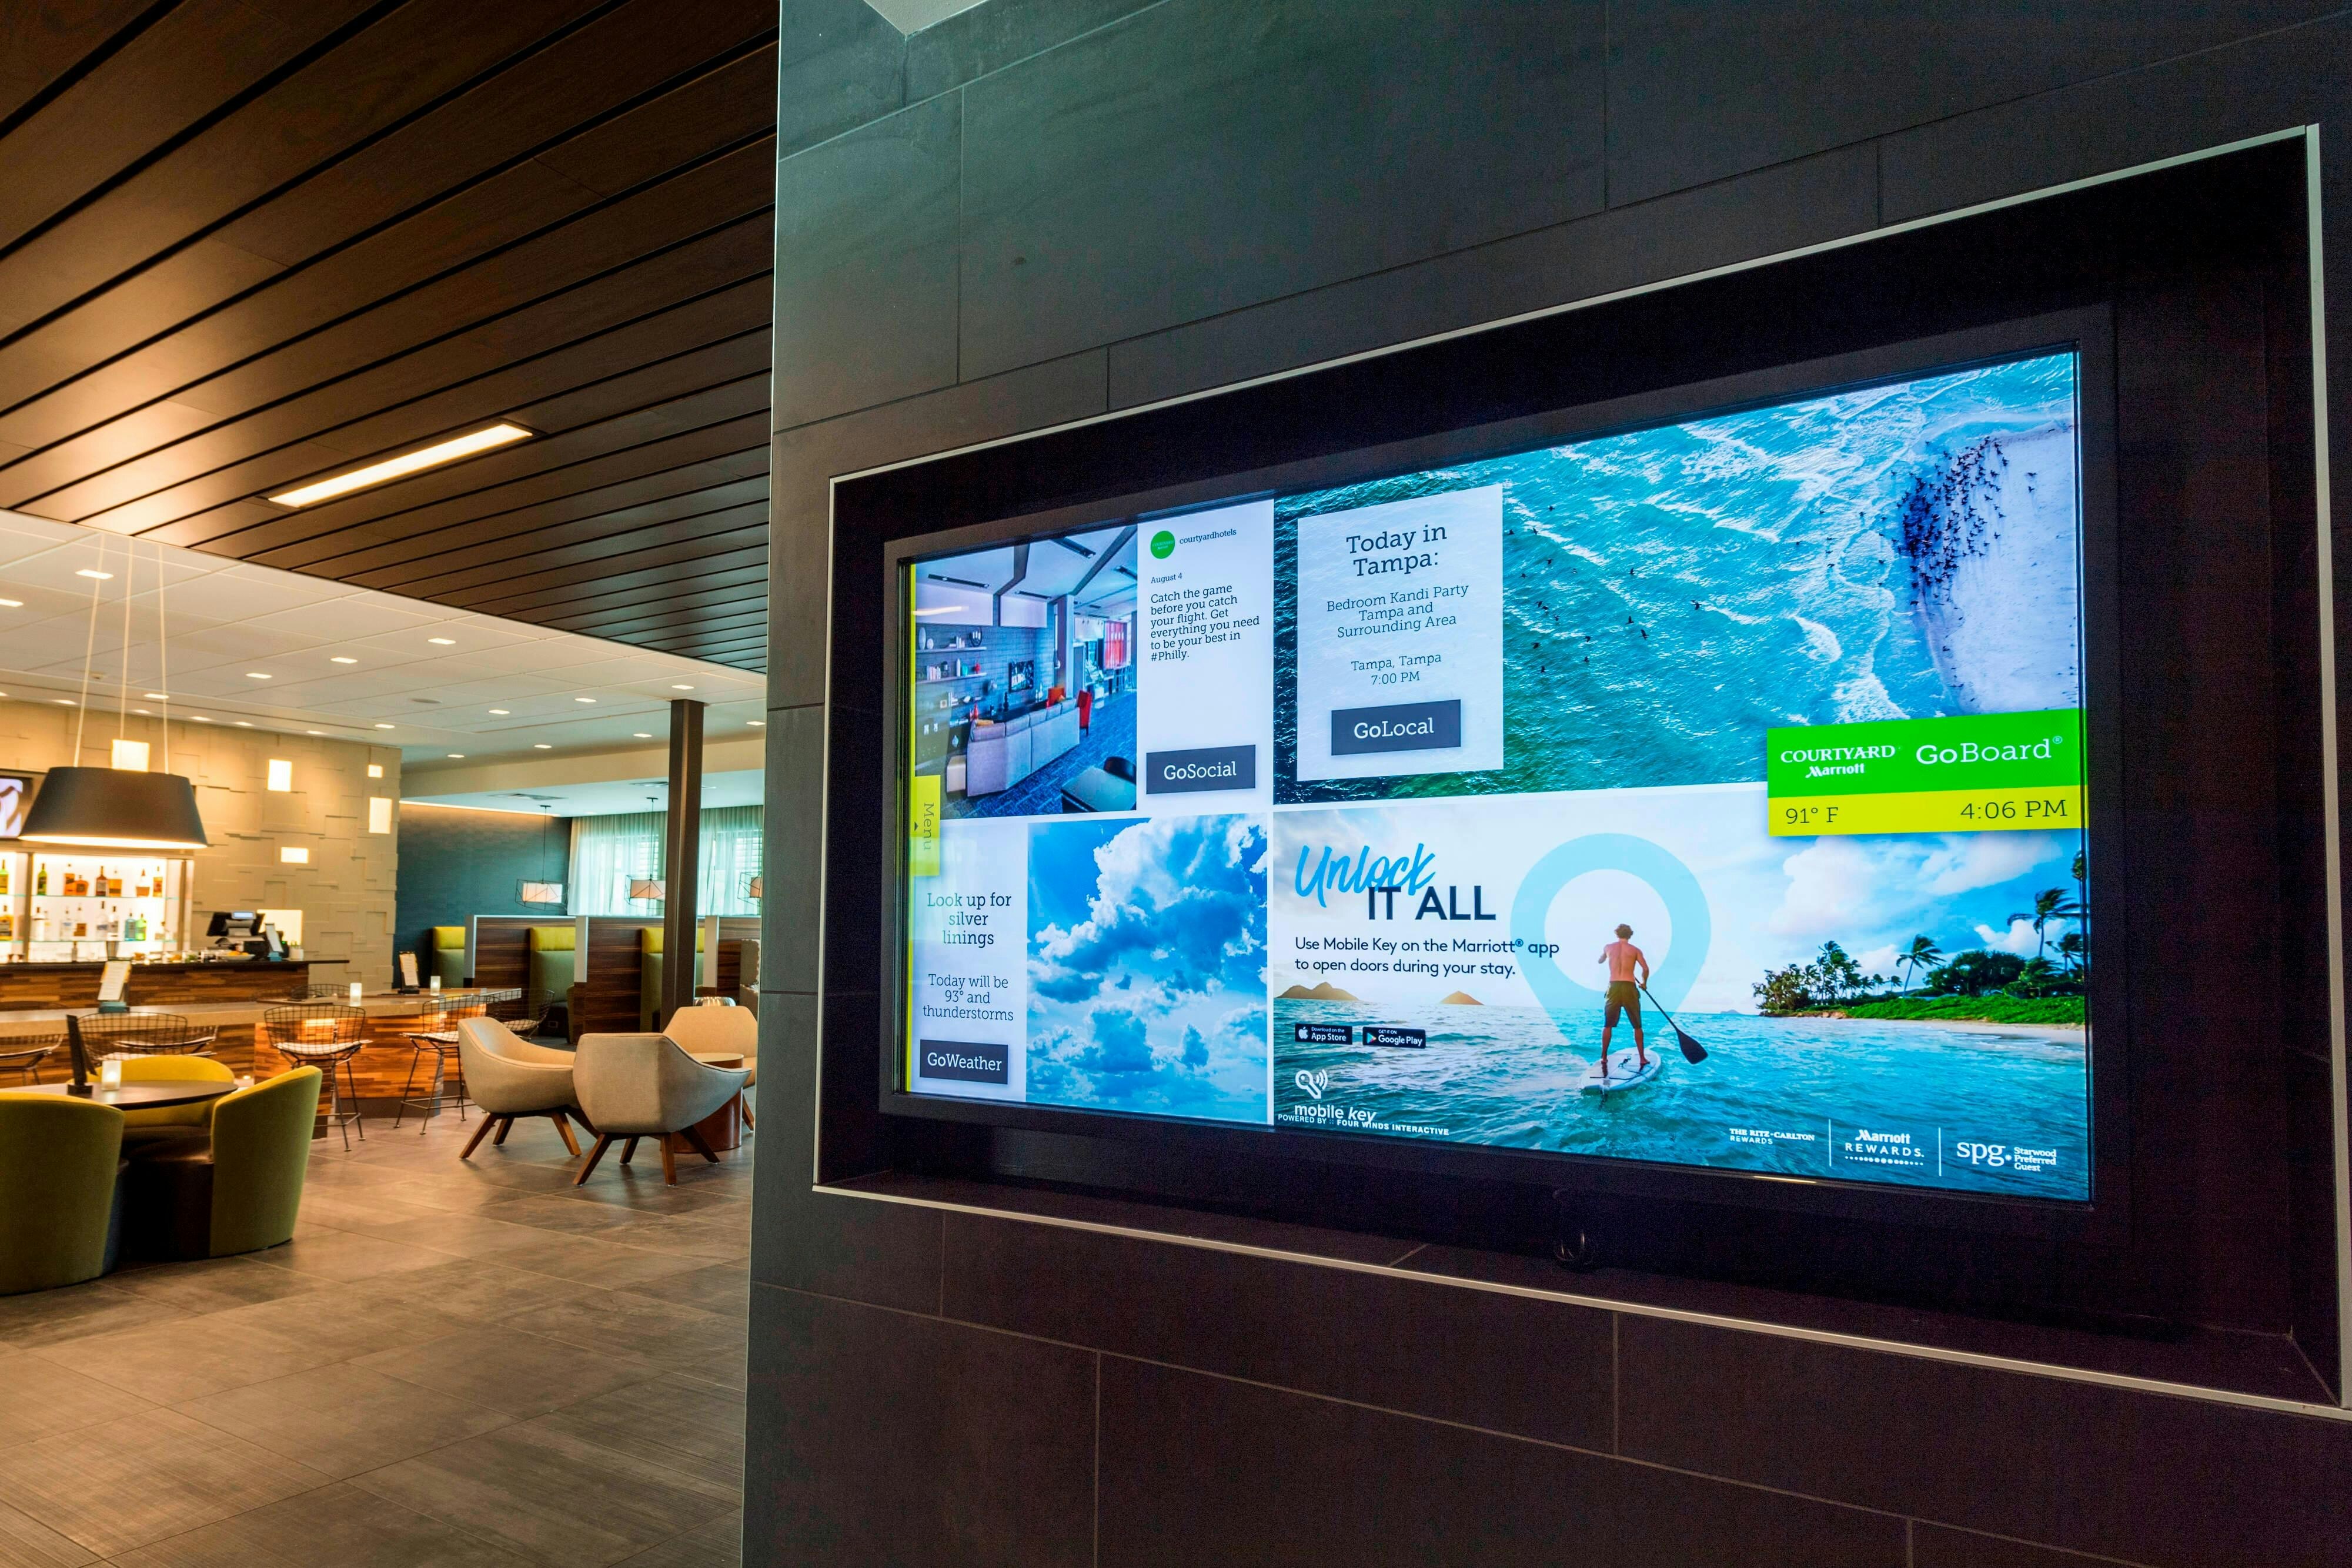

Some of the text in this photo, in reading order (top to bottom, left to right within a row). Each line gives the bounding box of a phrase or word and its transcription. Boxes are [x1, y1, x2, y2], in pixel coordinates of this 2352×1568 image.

[1180, 529, 1237, 544] courtyardhotels
[1346, 524, 1447, 554] Today in
[1353, 552, 1438, 576] Tampa:
[1151, 574, 1176, 584] August
[1151, 585, 1232, 603] Catch the game
[1327, 584, 1469, 612] Bedroom Kandi Party
[1151, 595, 1238, 615] before you catch
[1358, 602, 1434, 621] Tampa and
[1151, 608, 1228, 629] your flight. Get
[1151, 616, 1259, 638] everything you need
[1337, 614, 1456, 638] Surrounding Area
[1151, 631, 1241, 650] to be your best in
[1151, 649, 1190, 661] #Philly.
[1351, 653, 1442, 671] Tampa, Tampa
[1371, 671, 1421, 686] 7:00 PM
[1354, 717, 1434, 739] GoLocal
[1780, 745, 1896, 763] COURTYARD
[1164, 761, 1237, 780] GoSocial
[1805, 763, 1865, 778] Marriott
[1785, 807, 1839, 825] 91° F
[1960, 799, 2068, 820] 4:06 PM
[923, 803, 934, 851] Menu
[1295, 843, 1436, 908] Unlock
[927, 892, 1012, 910] Look up for
[1368, 885, 1496, 920] IT ALL
[948, 912, 988, 926] silver
[943, 930, 994, 948] linings
[1295, 937, 1319, 950] Use
[1324, 937, 1368, 951] Mobile
[1372, 938, 1397, 955] Key
[1401, 942, 1419, 952] on
[1423, 939, 1448, 952] the
[1528, 942, 1559, 958] app
[1295, 958, 1516, 978] to open doors during your stay.
[928, 974, 1008, 989] Today will be
[945, 990, 990, 1004] 93° and
[923, 1005, 1014, 1021] thunderstorms
[1311, 1032, 1326, 1041] App
[1378, 1035, 1422, 1046] Google Play
[927, 1052, 1002, 1071] GoWeather
[1294, 1104, 1377, 1124] mobile key
[1278, 1114, 1315, 1124] POWERED
[1337, 1119, 1359, 1128] FOUR
[1362, 1121, 1389, 1131] WINDS
[1392, 1124, 1449, 1136] INTERACTIVE
[1730, 1136, 1773, 1145] REWARDS
[1750, 1130, 1815, 1141] RITZ-CARLTON
[1855, 1129, 1910, 1144] Marriott
[2014, 1147, 2057, 1158] Starwood
[2014, 1155, 2056, 1165] Preferred
[2014, 1163, 2040, 1172] Guest
